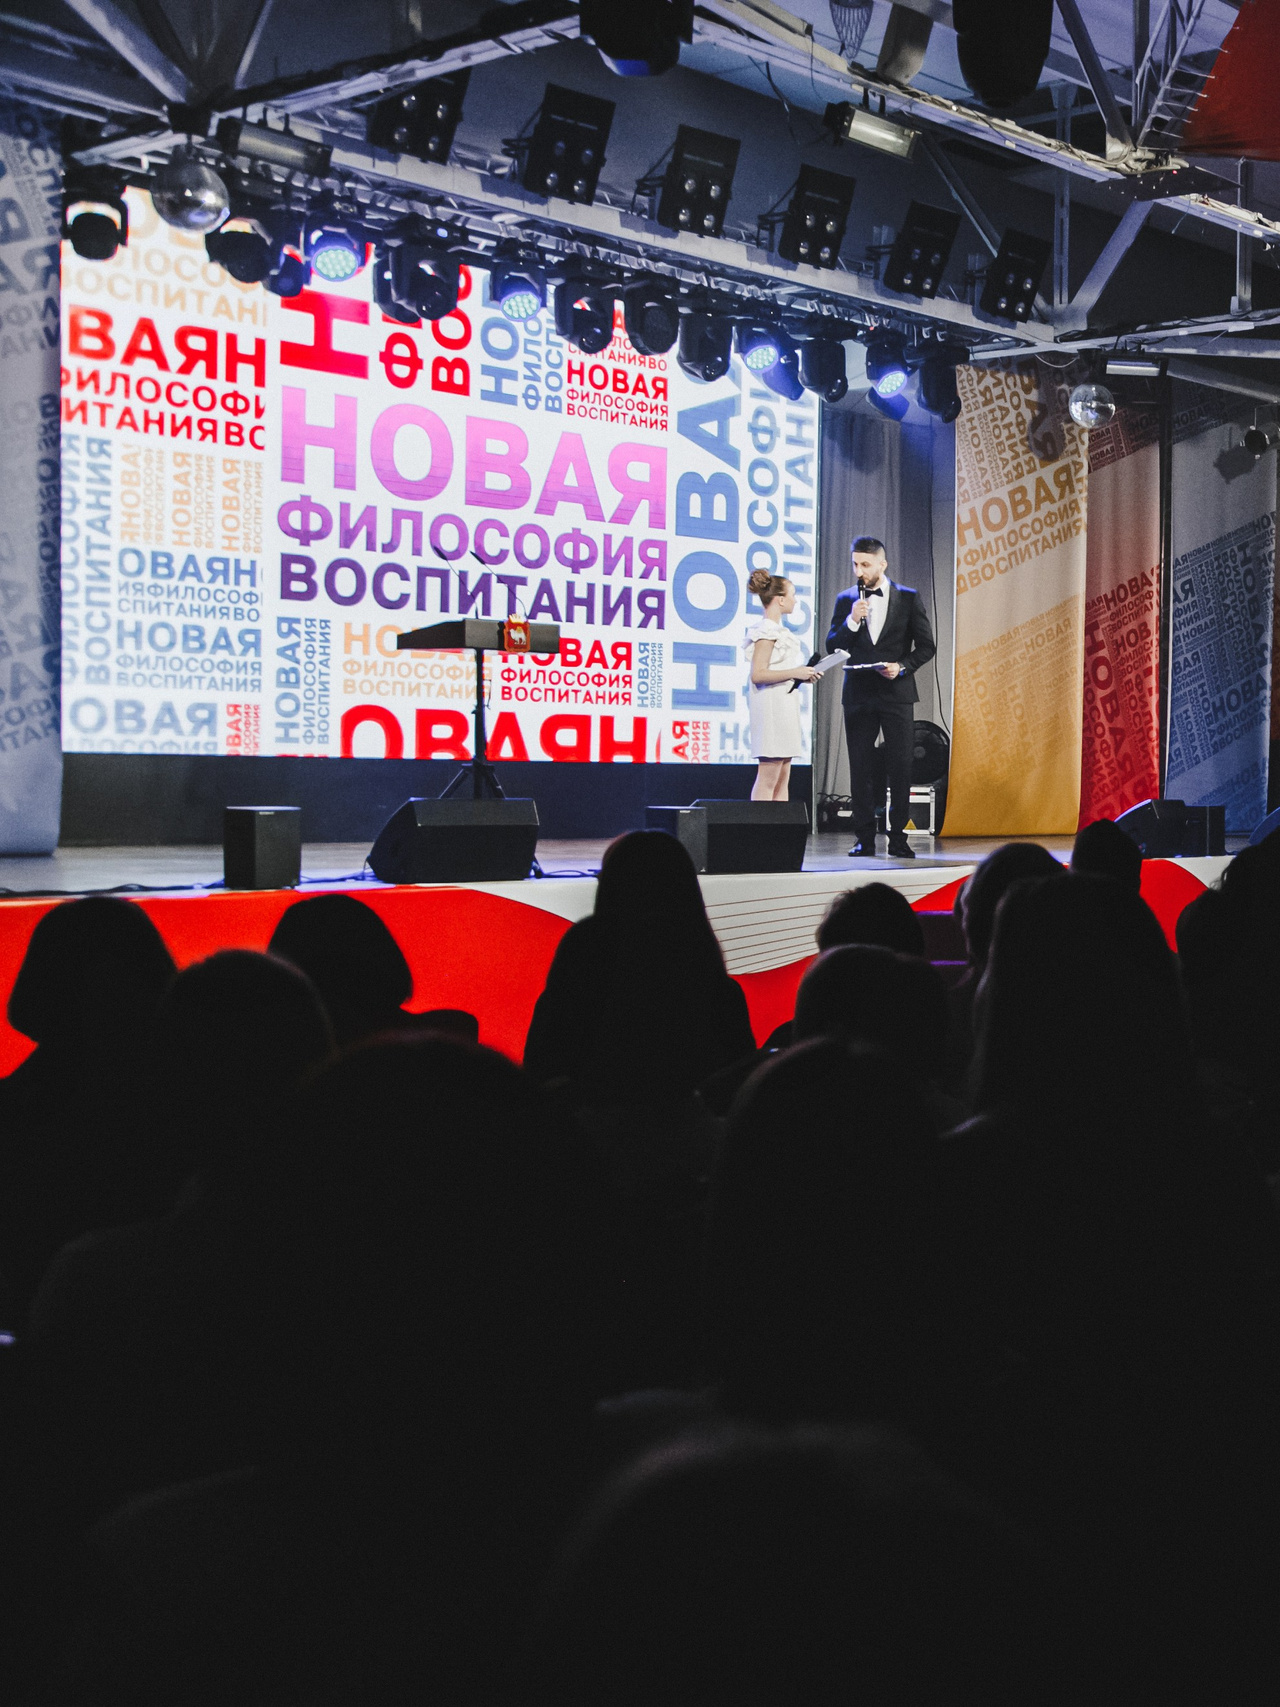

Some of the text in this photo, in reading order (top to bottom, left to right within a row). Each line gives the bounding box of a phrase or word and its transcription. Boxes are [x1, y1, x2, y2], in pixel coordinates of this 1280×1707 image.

[566, 388, 669, 417] ФИЛОСОФИЯ
[567, 359, 668, 401] НОВАЯ
[566, 403, 669, 431] ВОСПИТАНИЯ
[988, 407, 1014, 485] НОВАЯ
[281, 384, 668, 530] НОВАЯ
[966, 416, 992, 494] НОВАЯ
[172, 452, 192, 547] НОВАЯ
[221, 458, 241, 552] НОВАЯ
[957, 462, 1076, 546] НОВАЯ
[85, 436, 112, 686] ВОСПИТАНИЯ
[277, 495, 668, 582] ФИЛОСОФИЯ
[963, 498, 1082, 568] ФИЛОСОФИЯ
[118, 547, 263, 588] ОВАЯН
[280, 552, 667, 630] ВОСПИТАНИЯ
[1024, 616, 1072, 653] НОВАЯ
[1110, 590, 1154, 621] ФИЛОСОФ
[1182, 617, 1216, 642] НОВАЯ
[115, 654, 263, 676] ФИЛОСОФИЯ
[116, 619, 263, 658] НОВАЯ
[115, 672, 263, 693] ВОСПИТАНИЯ
[275, 616, 301, 744] НОВАЯ
[303, 617, 317, 745] ФИЛОСОФИЯ
[318, 619, 331, 745] ВОСПИТАНИЯ
[501, 667, 633, 689] ФИЛОСОФИЯ
[501, 686, 633, 706] ВОСПИТАНИЯ
[637, 642, 650, 708] НОВАЯ
[1212, 672, 1267, 723] НОВА
[69, 697, 218, 737] ОВАЯ
[341, 704, 662, 764] ОВАЯН
